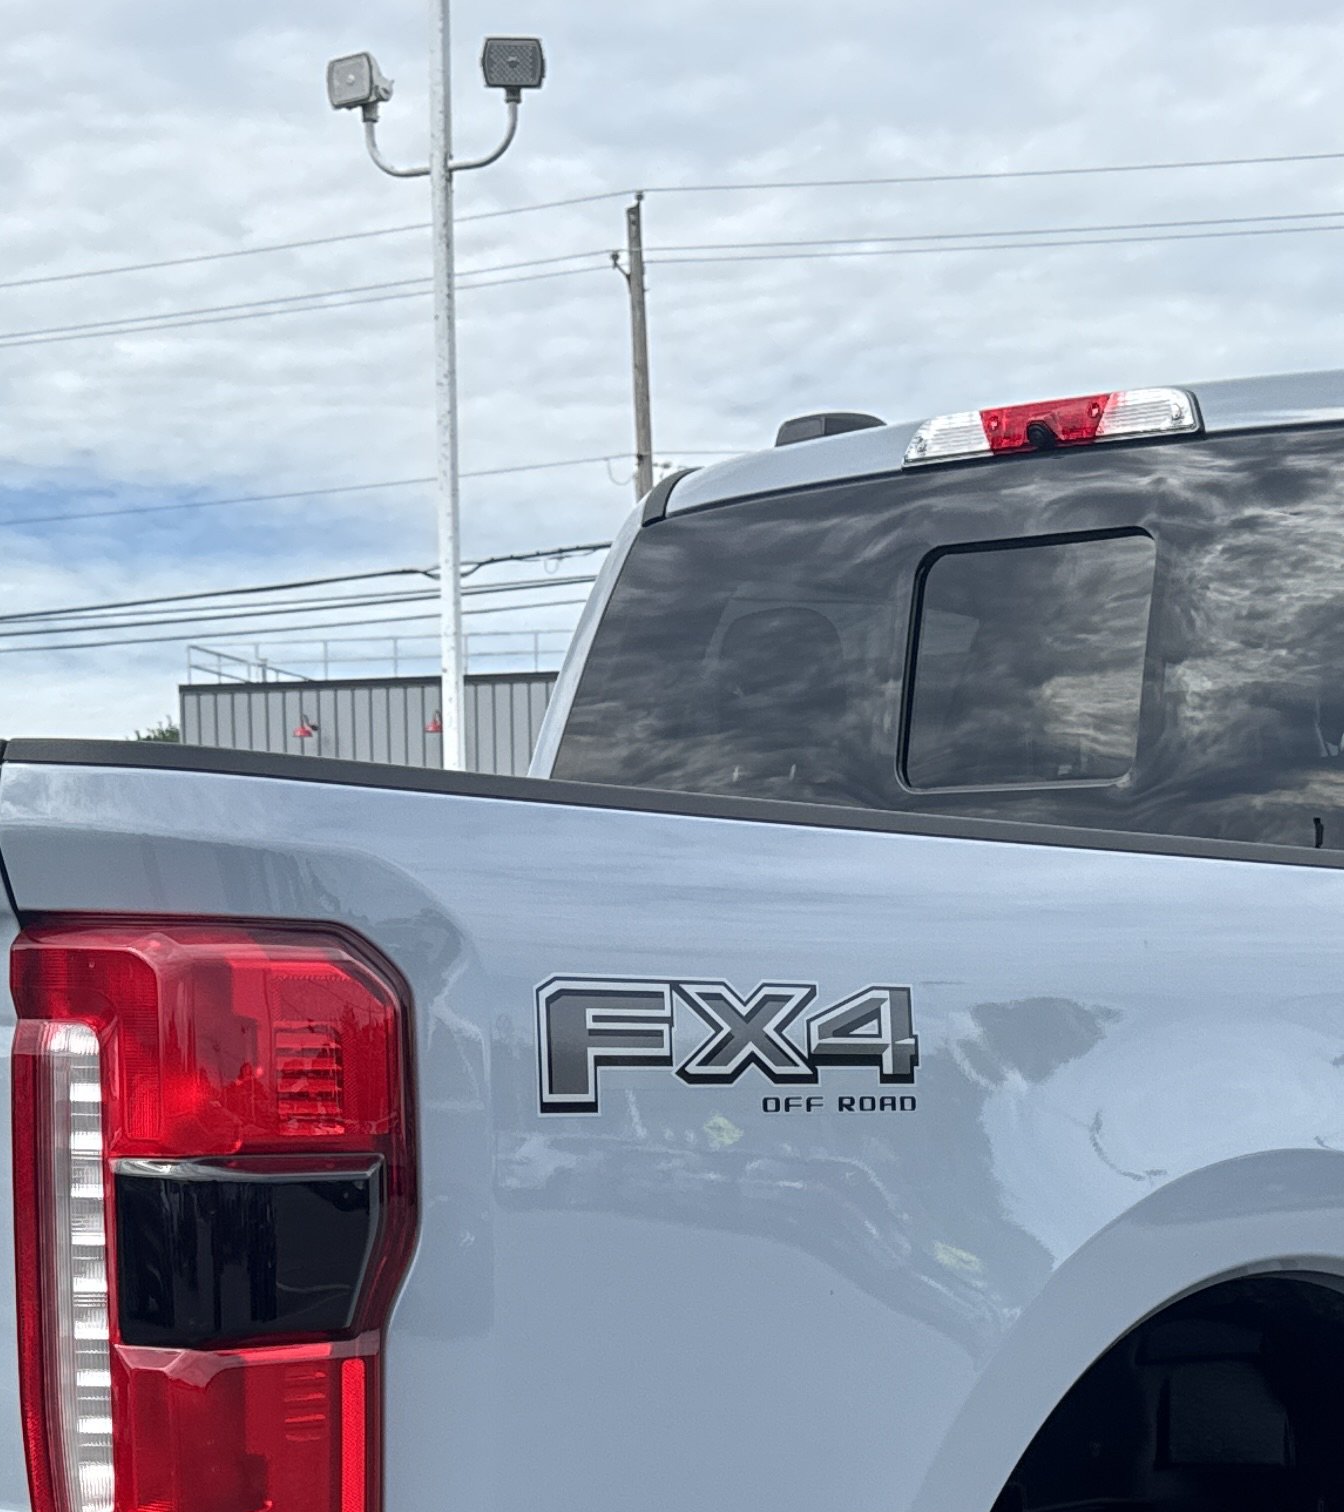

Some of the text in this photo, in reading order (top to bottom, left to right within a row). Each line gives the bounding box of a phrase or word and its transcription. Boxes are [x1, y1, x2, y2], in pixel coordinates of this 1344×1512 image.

[534, 972, 920, 1117] FX4
[762, 1095, 918, 1114] OFF ROAD
